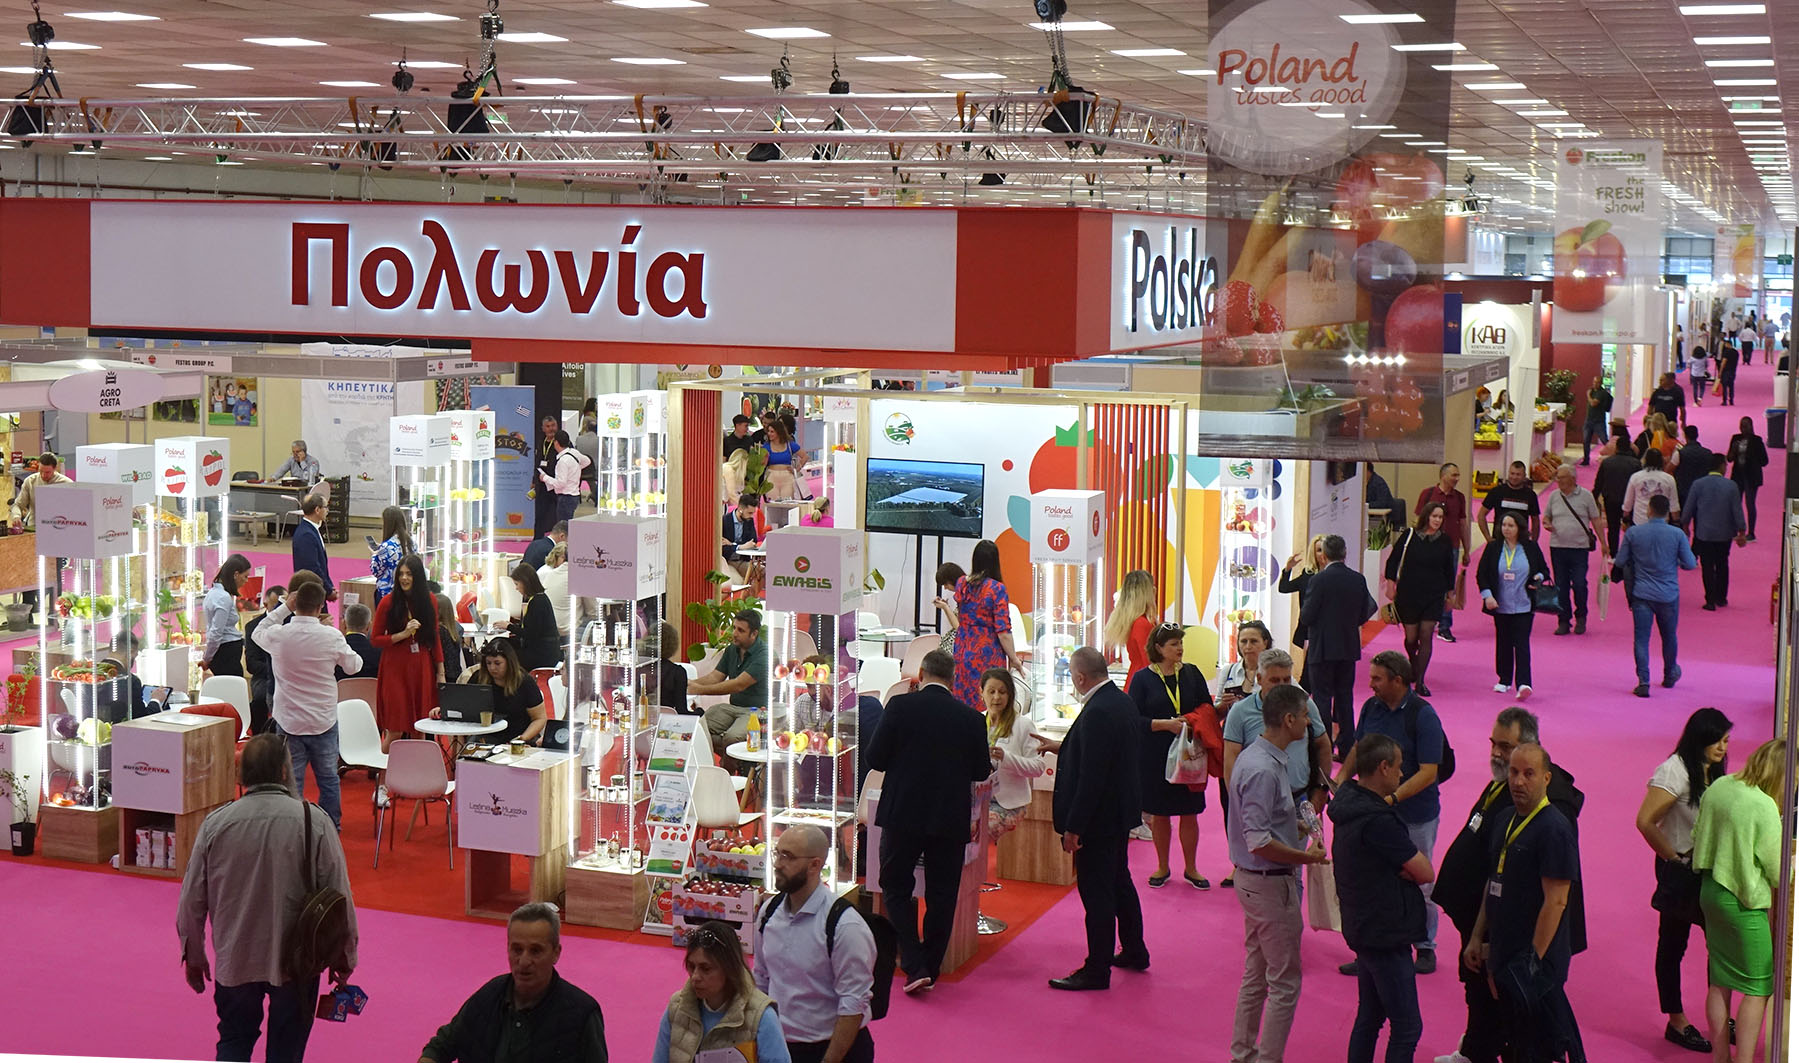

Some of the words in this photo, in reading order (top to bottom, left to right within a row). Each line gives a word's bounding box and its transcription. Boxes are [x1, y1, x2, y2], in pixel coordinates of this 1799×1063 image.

[1217, 41, 1359, 86] Poland
[1236, 84, 1302, 105] tastes
[1309, 80, 1367, 112] good
[1586, 150, 1646, 162] Freskon
[1627, 176, 1645, 185] the
[1595, 187, 1645, 200] FRESH
[1604, 200, 1645, 214] show!
[291, 219, 707, 319] Πολωνία
[1131, 226, 1219, 333] Polska
[100, 388, 121, 398] AGRO
[99, 398, 121, 407] CRETA
[1044, 505, 1072, 515] Poland
